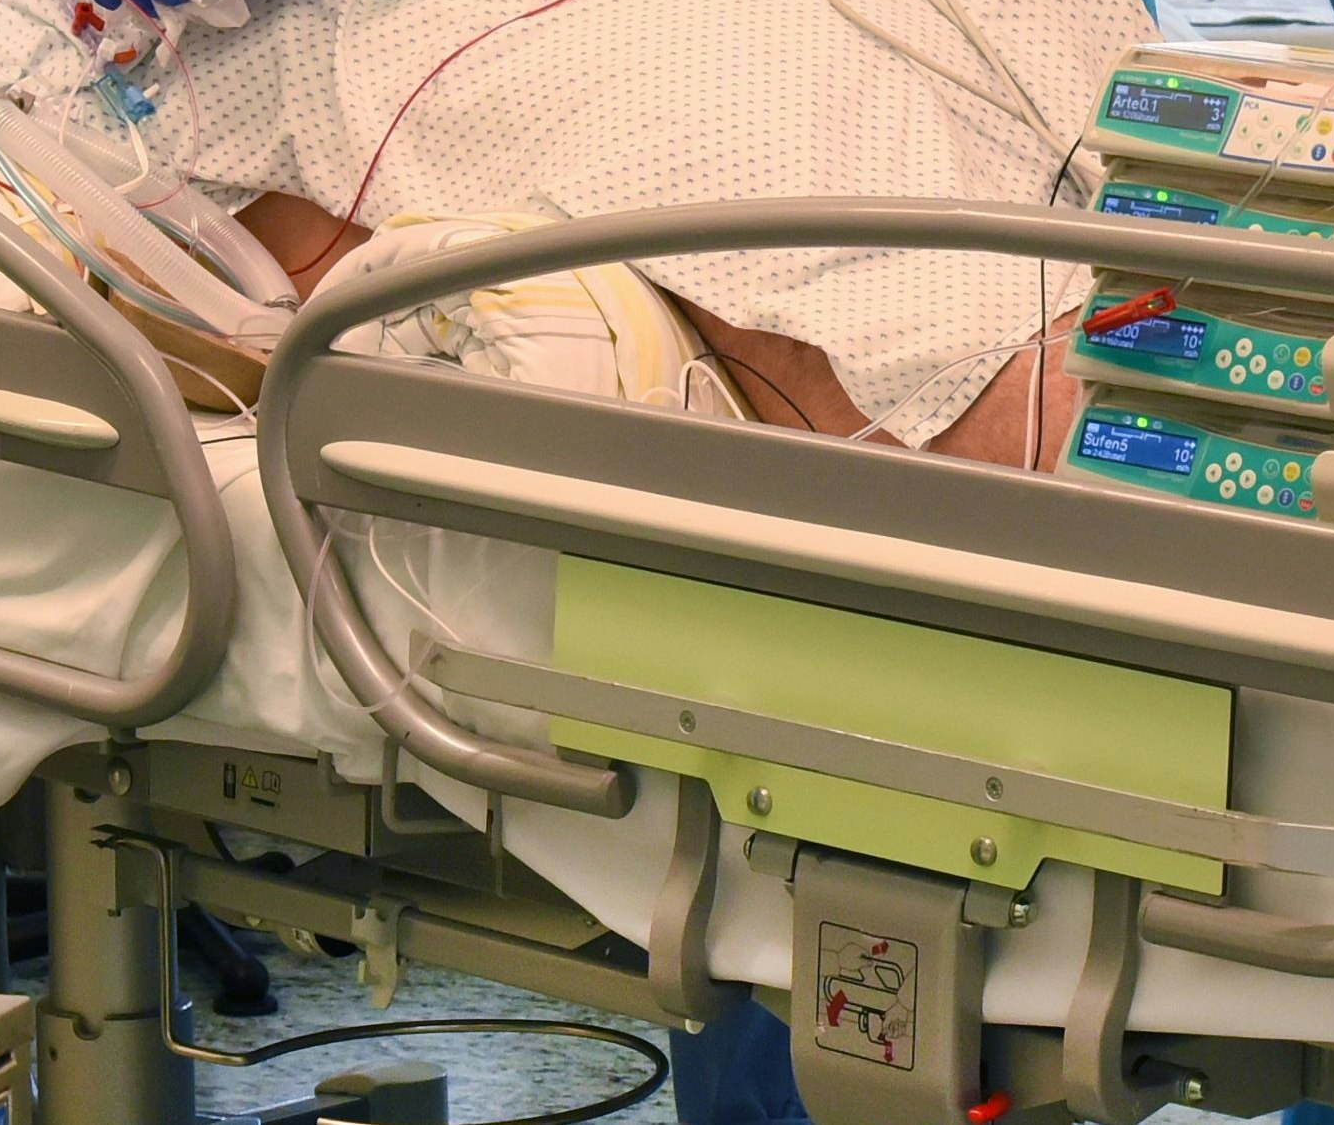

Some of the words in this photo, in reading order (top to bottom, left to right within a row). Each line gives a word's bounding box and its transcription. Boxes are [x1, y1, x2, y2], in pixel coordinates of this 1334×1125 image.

[1182, 334, 1199, 349] 10
[1084, 432, 1128, 452] Sufen5
[1174, 448, 1190, 463] 10
